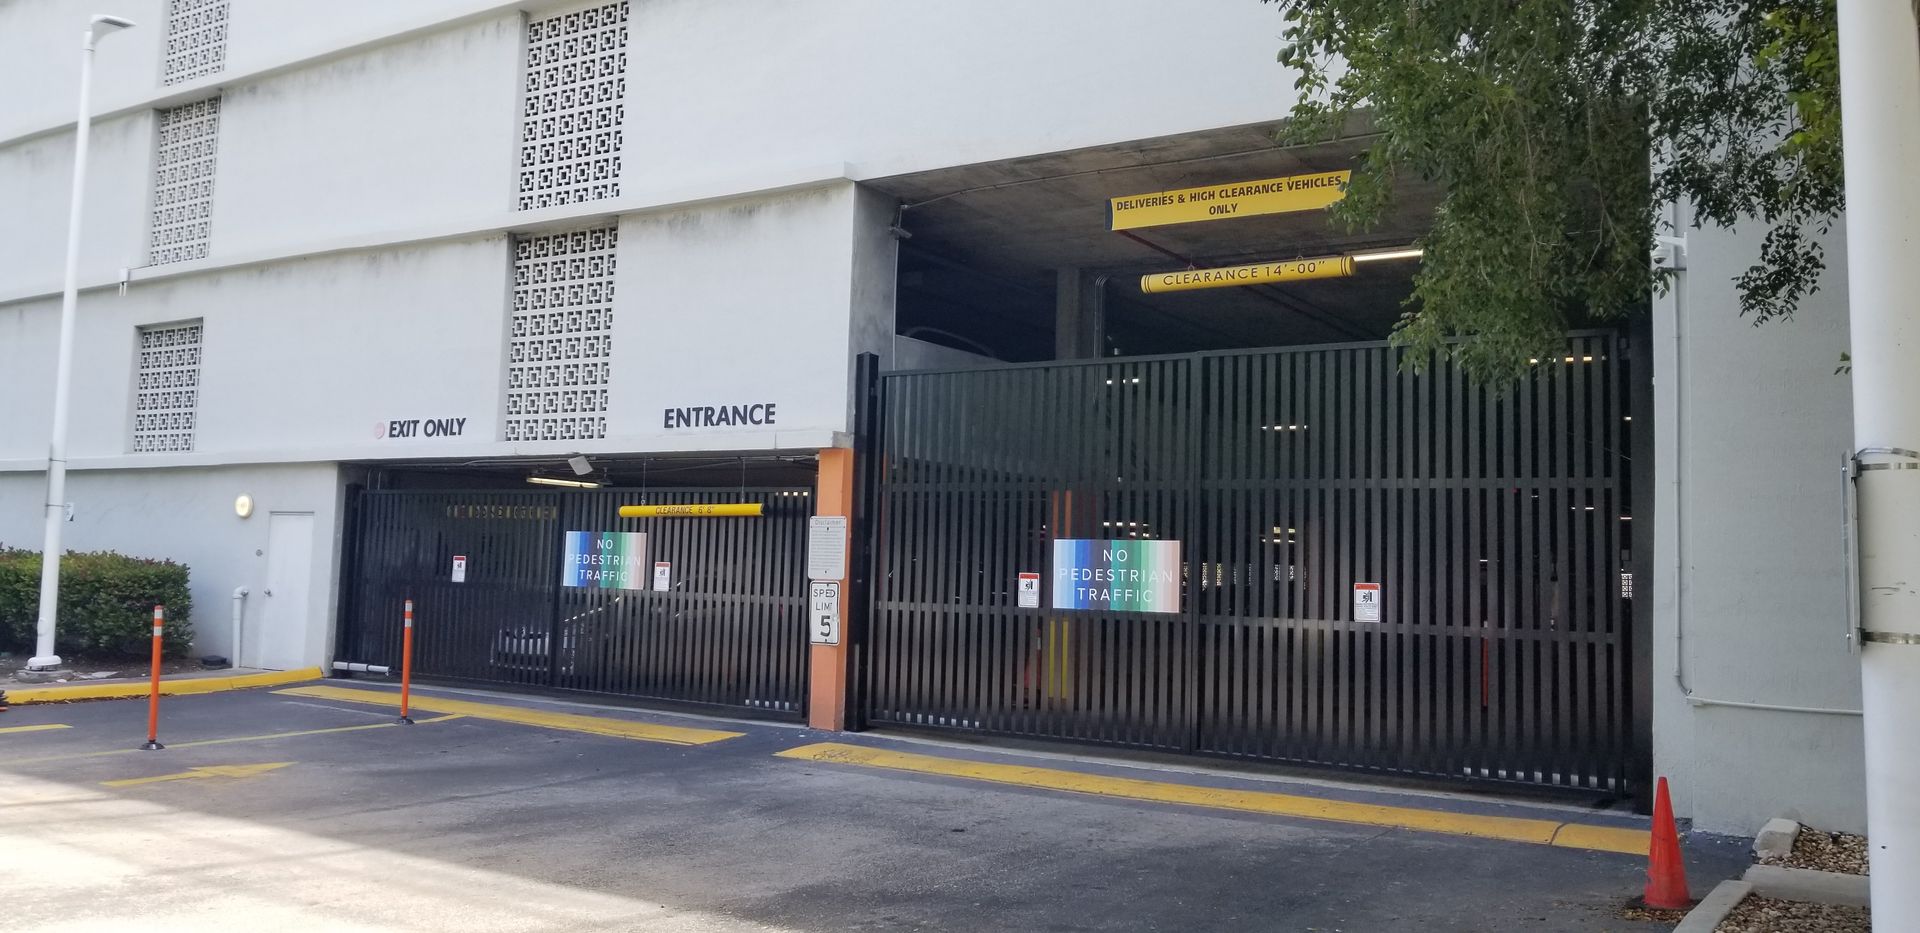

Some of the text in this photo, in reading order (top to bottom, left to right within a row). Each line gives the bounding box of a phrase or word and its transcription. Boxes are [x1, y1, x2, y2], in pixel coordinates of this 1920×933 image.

[1116, 175, 1342, 211] DELIVERIES & HIGH CLEARANCE VEHICLES
[1208, 203, 1238, 215] ONLY
[1163, 267, 1258, 286] CLEARANCE
[664, 403, 776, 428] ENTRANCE
[388, 417, 466, 438] EXIT ONLY
[655, 505, 693, 515] CLEARANCE
[597, 538, 614, 550] NO
[569, 554, 641, 567] PEDESTRIAN
[1103, 549, 1128, 562] NO
[579, 569, 629, 582] TRAFFIC
[1059, 568, 1173, 583] PEDESTRIAN
[1077, 587, 1153, 602] TRAFFIC
[820, 614, 832, 637] 5
